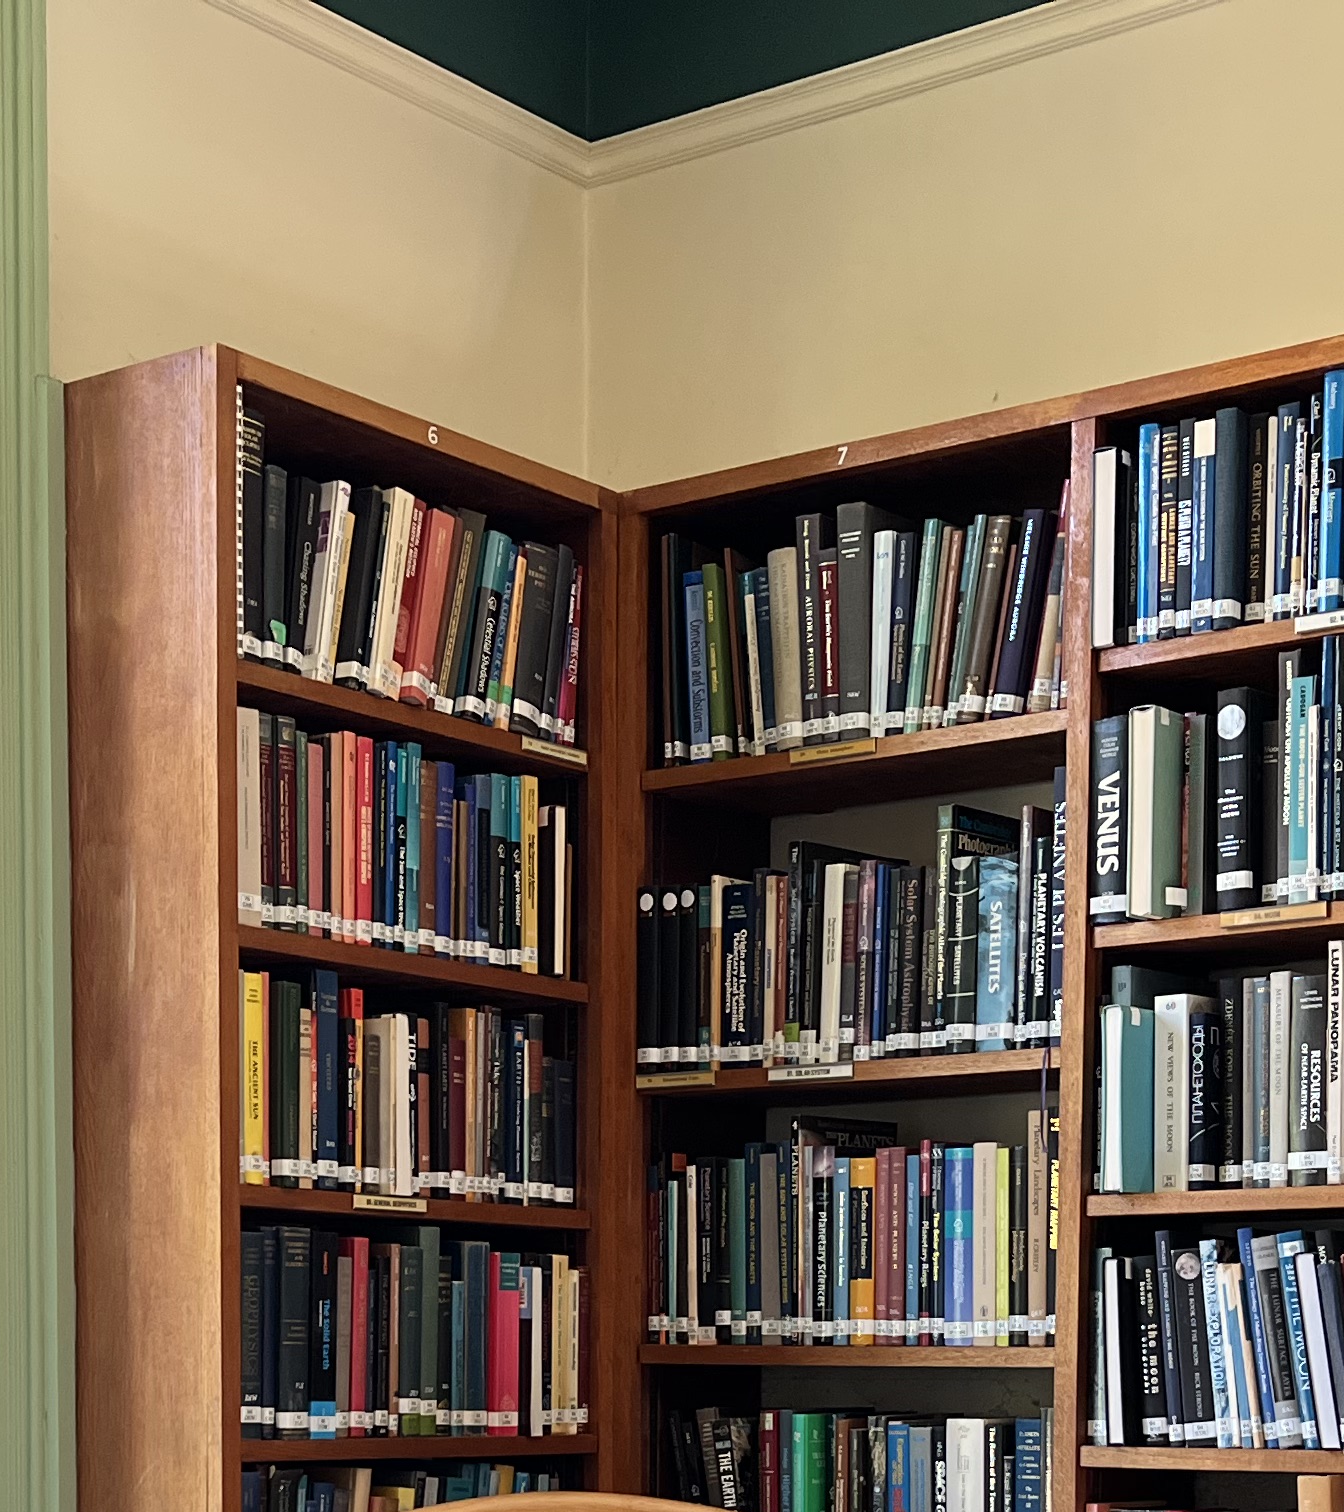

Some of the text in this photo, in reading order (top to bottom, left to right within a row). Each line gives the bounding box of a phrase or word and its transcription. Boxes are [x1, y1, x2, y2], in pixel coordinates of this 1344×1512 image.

[428, 425, 438, 445] 6
[837, 446, 849, 466] 7
[1250, 463, 1262, 579] ORBITING THE SUN
[297, 542, 313, 625] Chasing Shadows
[1008, 519, 1034, 642] MELANIE WINDRIDGE AURORA
[477, 617, 496, 693] Celestial Shadows
[690, 618, 704, 734] Convection and Substorms
[1096, 771, 1120, 876] VENUS
[988, 900, 1003, 994] SATELLITES
[1034, 873, 1047, 997] PLANETARY VOLCANISM
[1301, 1043, 1308, 1053] OF
[1330, 948, 1340, 1083] LUNAR PANORAMA
[1166, 1056, 1174, 1083] VIEWS
[1166, 1086, 1174, 1098] OF
[1300, 1055, 1308, 1104] NEAR-EARTH
[1310, 1050, 1321, 1122] RESOURCES
[251, 1102, 259, 1120] SUN
[1166, 1102, 1174, 1121] THE
[1166, 1124, 1174, 1153] MOON
[816, 1211, 827, 1308] Planetary Sciences
[247, 1275, 259, 1375] GEOPHYSICS
[322, 1299, 331, 1370] The Solid Earth
[1203, 1261, 1225, 1389] LUNAR EXPLORATION
[935, 1461, 946, 1502] SPACE
